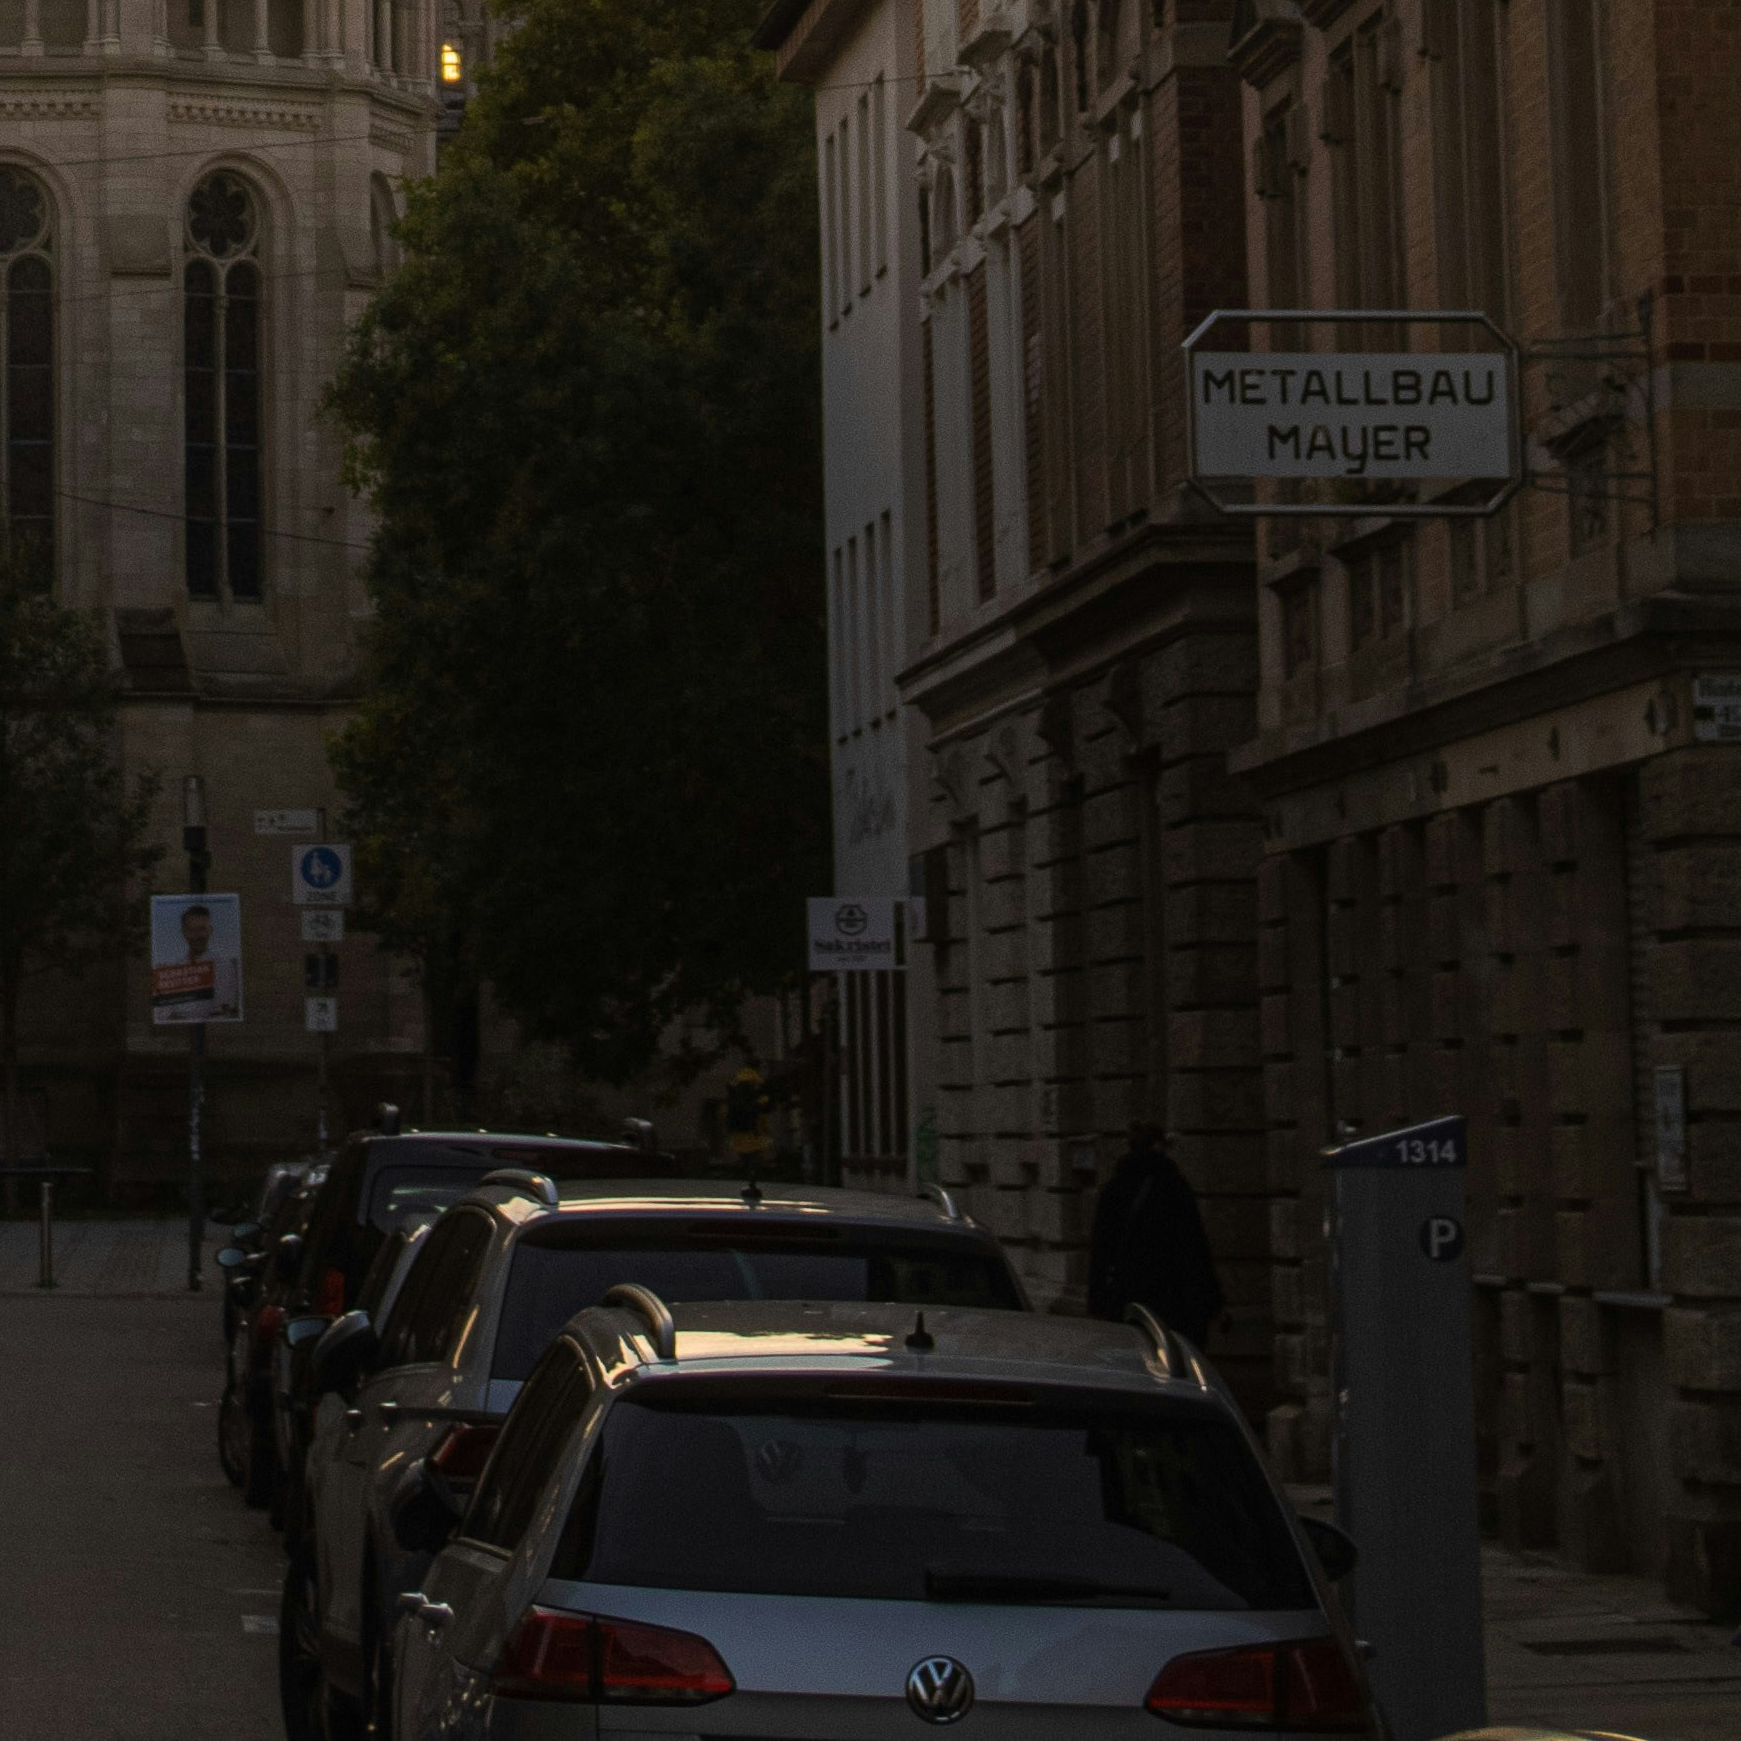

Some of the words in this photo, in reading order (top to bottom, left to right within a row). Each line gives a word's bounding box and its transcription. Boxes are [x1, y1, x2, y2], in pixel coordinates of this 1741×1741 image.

[1204, 369, 1493, 406] METALLBAU
[1267, 424, 1430, 475] MAYER
[1396, 1139, 1456, 1163] 1314
[1429, 1218, 1457, 1258] P
